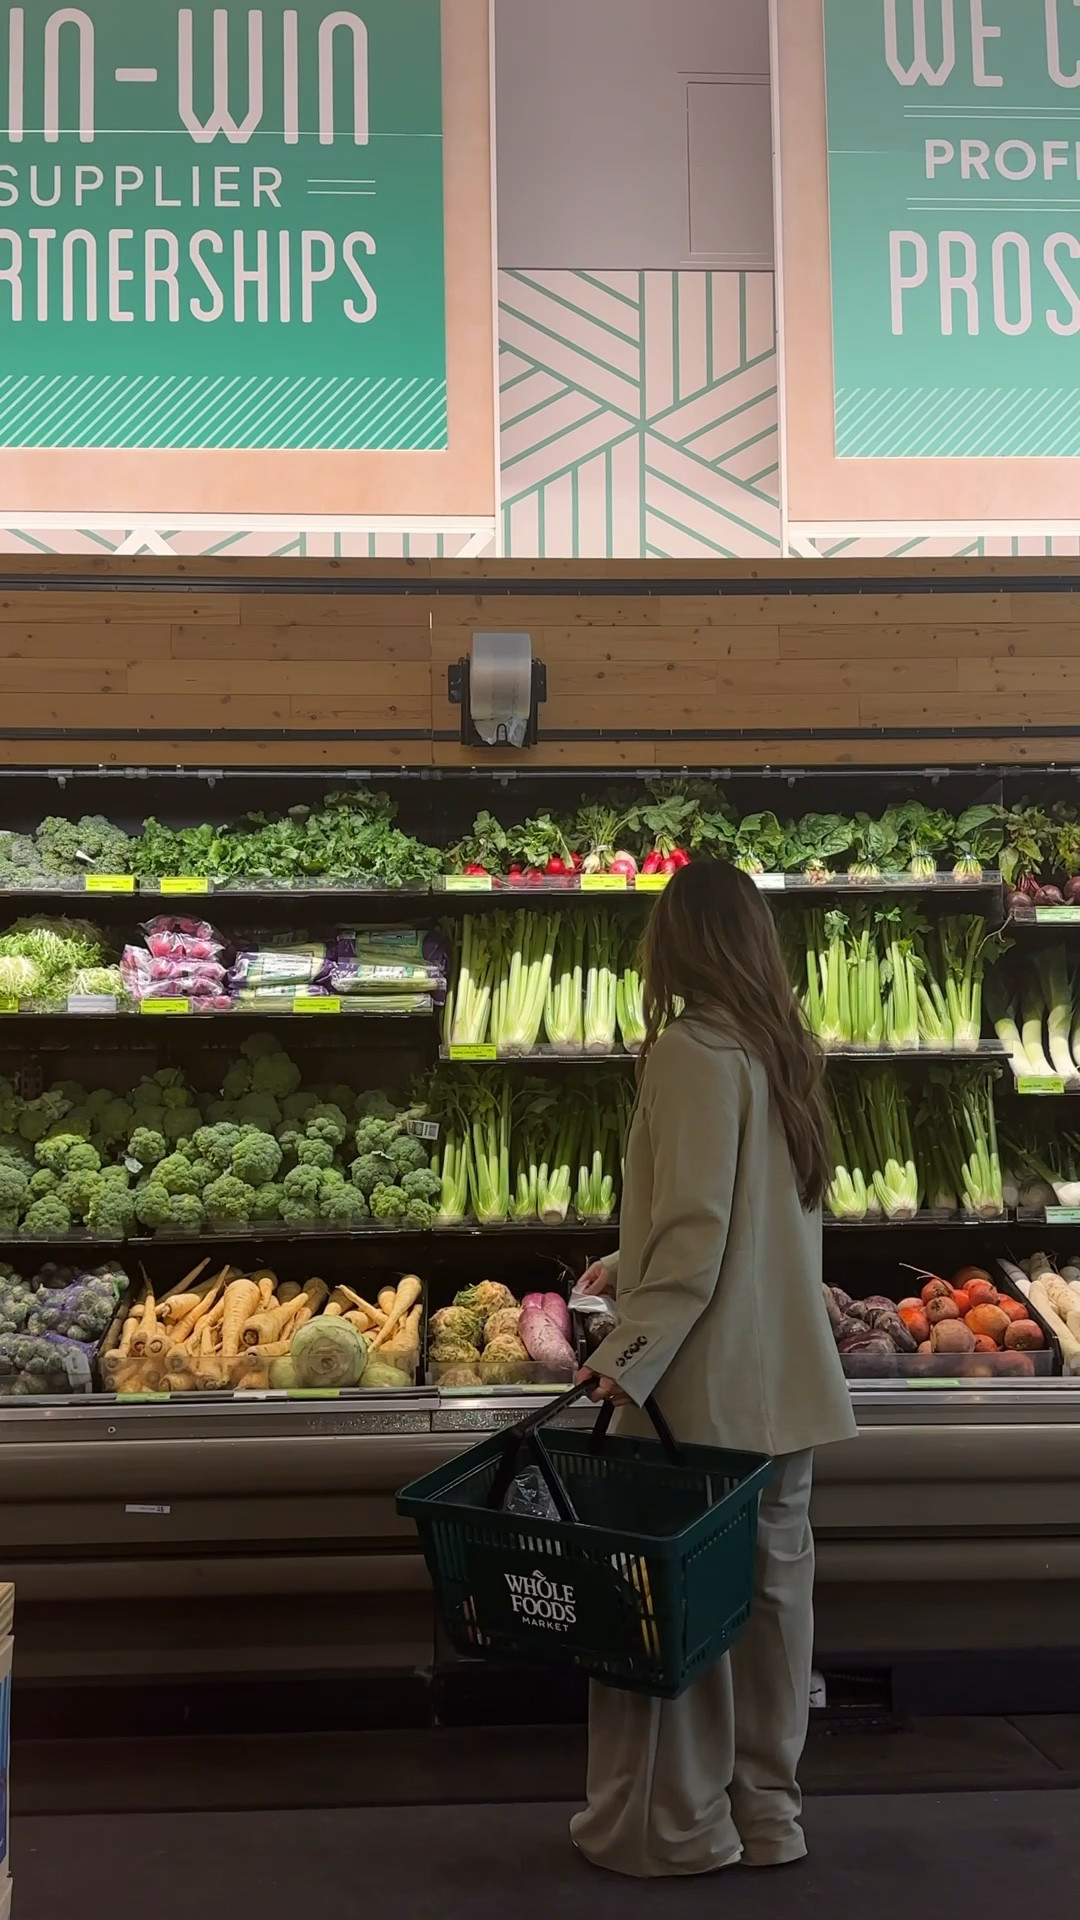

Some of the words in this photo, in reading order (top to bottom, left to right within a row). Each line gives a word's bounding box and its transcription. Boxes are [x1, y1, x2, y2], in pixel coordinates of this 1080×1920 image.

[884, 0, 1004, 87] WE
[0, 164, 284, 208] SUPPLIER
[889, 230, 1080, 336] PROS
[503, 1570, 576, 1604] WHOLE
[510, 1593, 577, 1624] FOODS
[522, 1616, 569, 1632] MARKET
